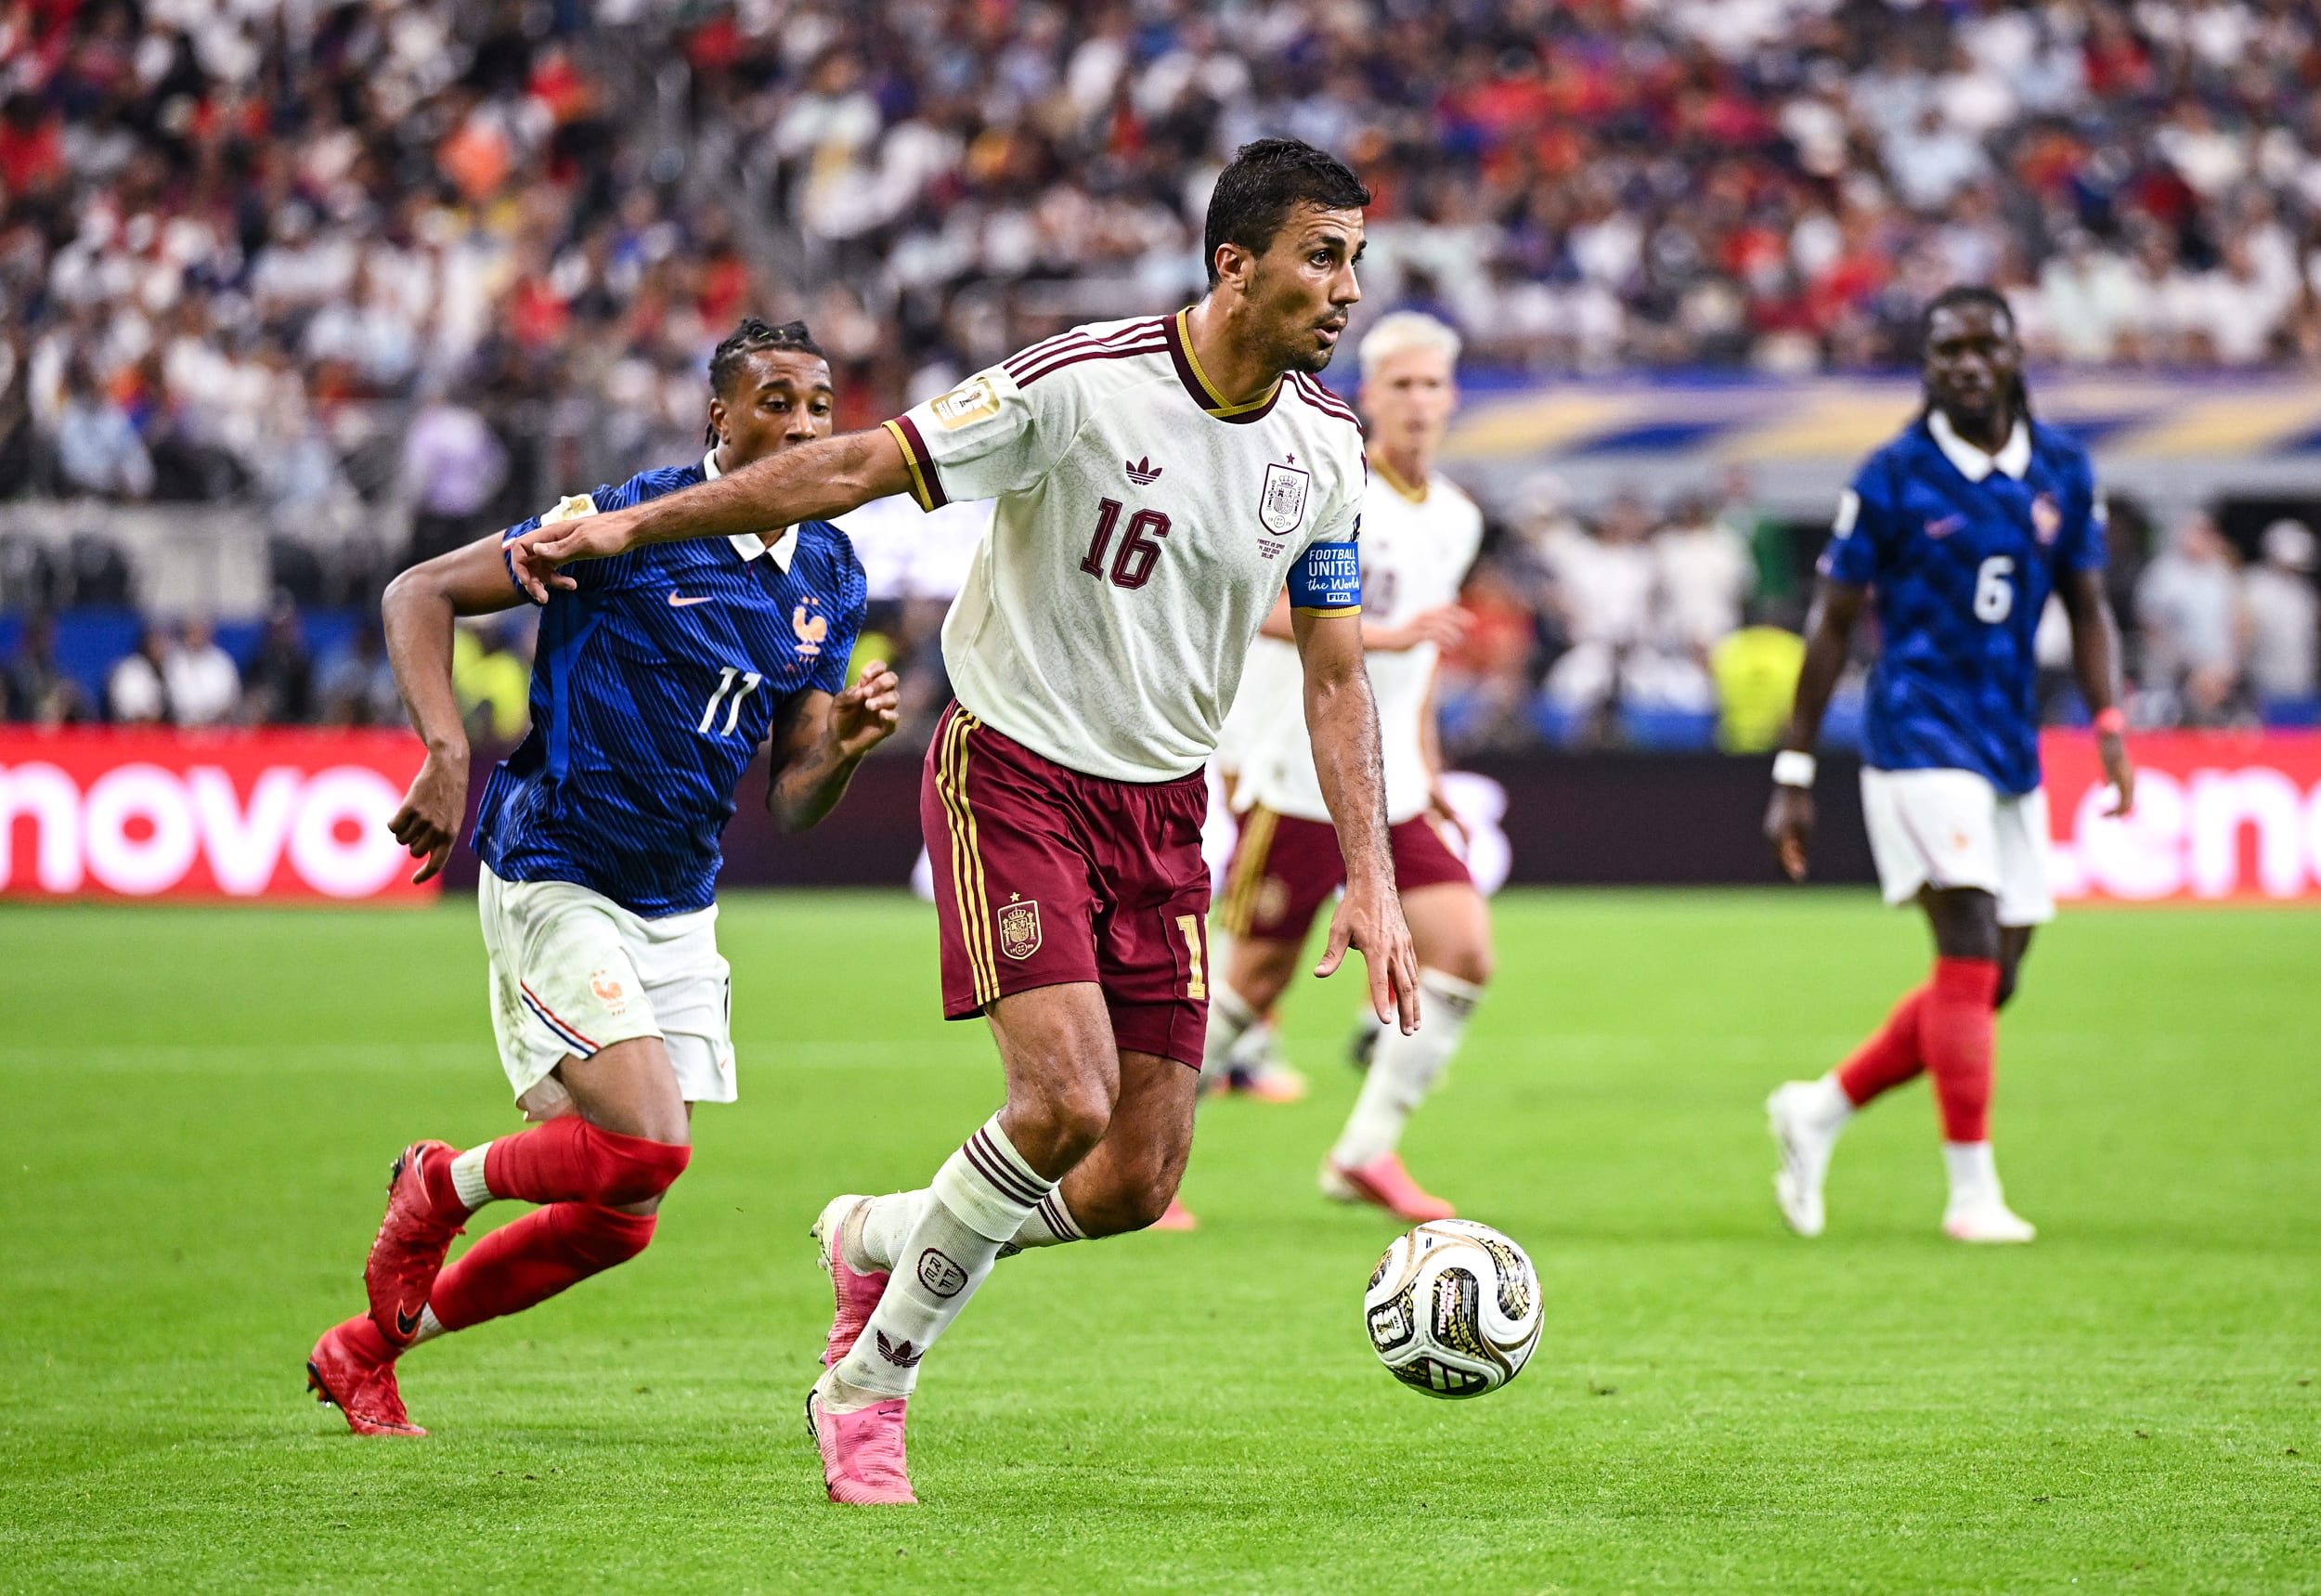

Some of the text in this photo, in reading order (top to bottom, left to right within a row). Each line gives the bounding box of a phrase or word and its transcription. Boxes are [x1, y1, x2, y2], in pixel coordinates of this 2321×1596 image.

[1080, 497, 1172, 590] 16
[1309, 549, 1355, 561] FOOTBALL
[1306, 576, 1360, 591] the World
[1308, 560, 1356, 577] UNITES
[1974, 555, 2014, 624] 6
[1328, 593, 1349, 602] FIFA
[697, 666, 762, 736] 11
[1176, 914, 1208, 1000] 1
[1438, 1278, 1448, 1336] TRIONDA
[1447, 1278, 1457, 1317] FINAL
